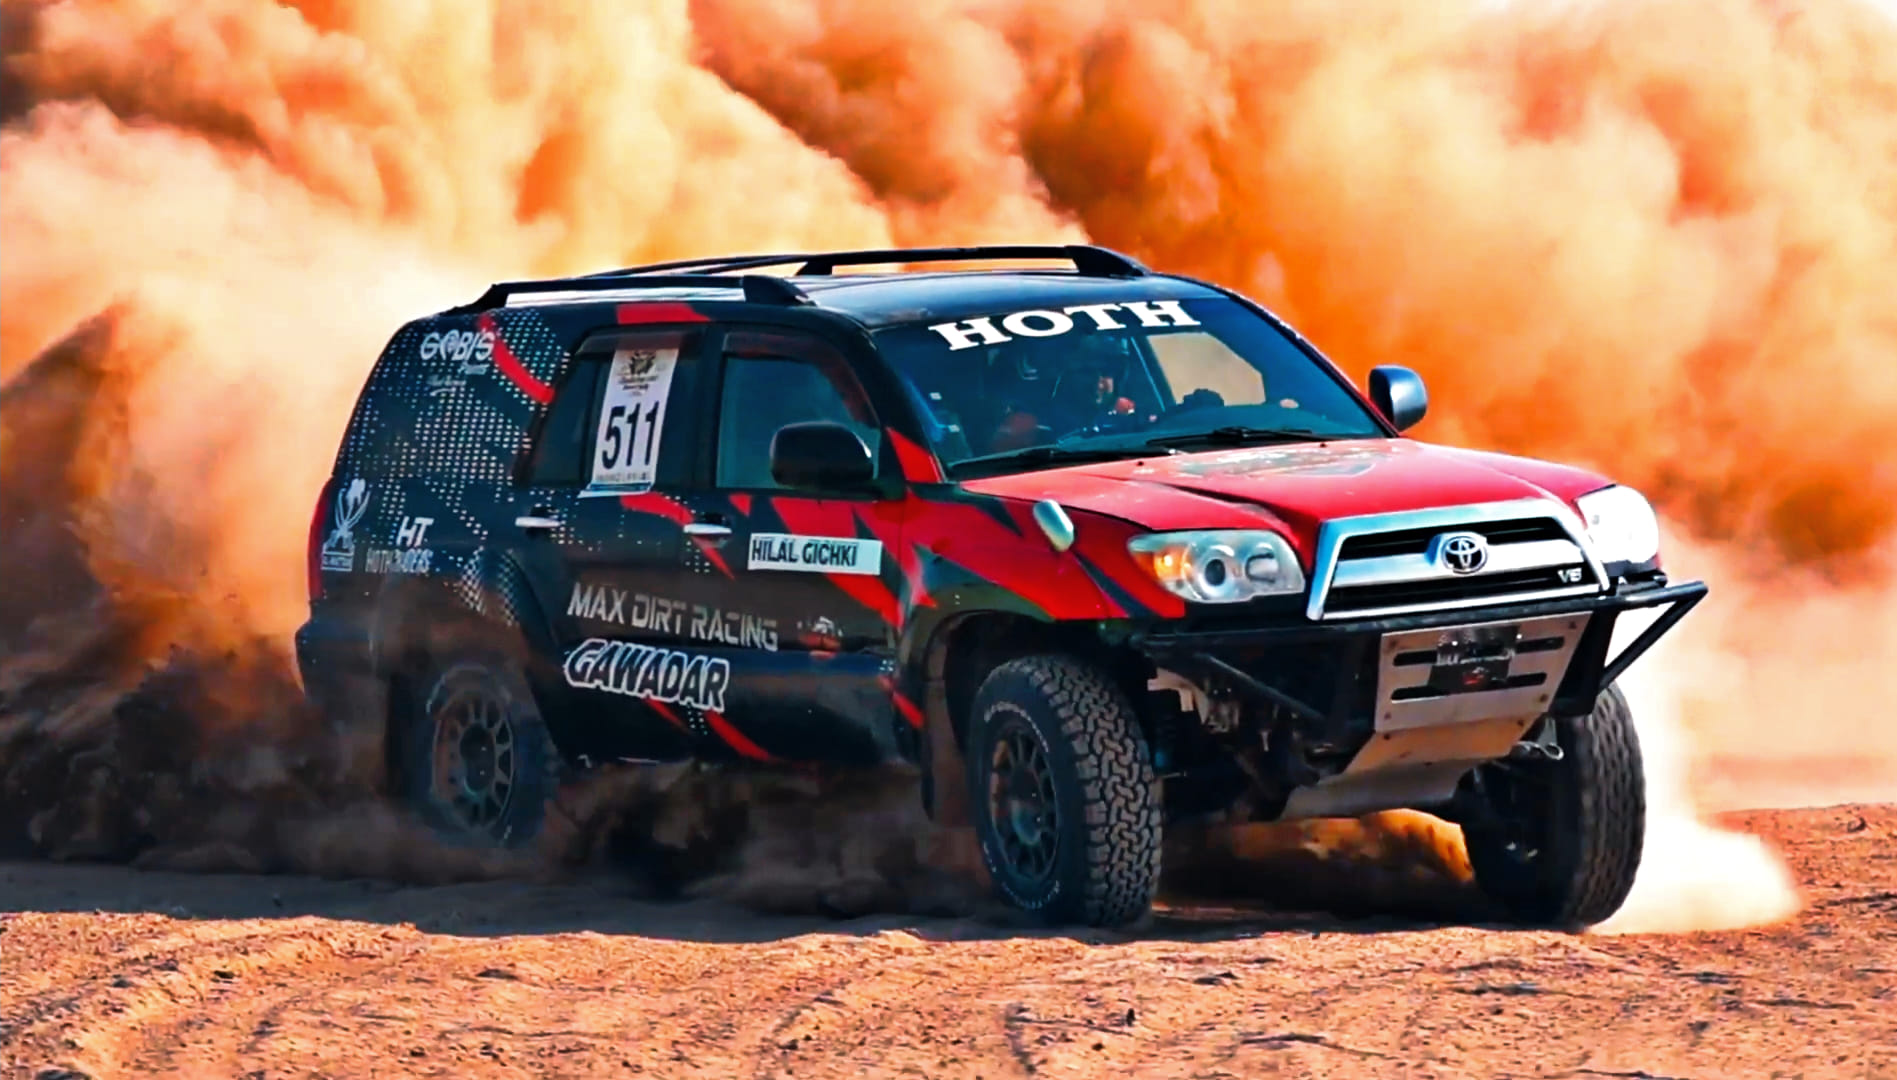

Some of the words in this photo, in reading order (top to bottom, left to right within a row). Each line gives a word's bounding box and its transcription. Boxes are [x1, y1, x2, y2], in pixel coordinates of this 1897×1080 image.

[928, 300, 1201, 351] HOTH
[602, 400, 659, 469] 511
[396, 516, 435, 547] HT
[752, 538, 799, 563] HILAL
[802, 541, 857, 567] GICHKI
[567, 582, 628, 625] MAX
[631, 593, 687, 635] DIRT
[690, 603, 778, 653] RACING
[564, 637, 730, 713] GAWADAR
